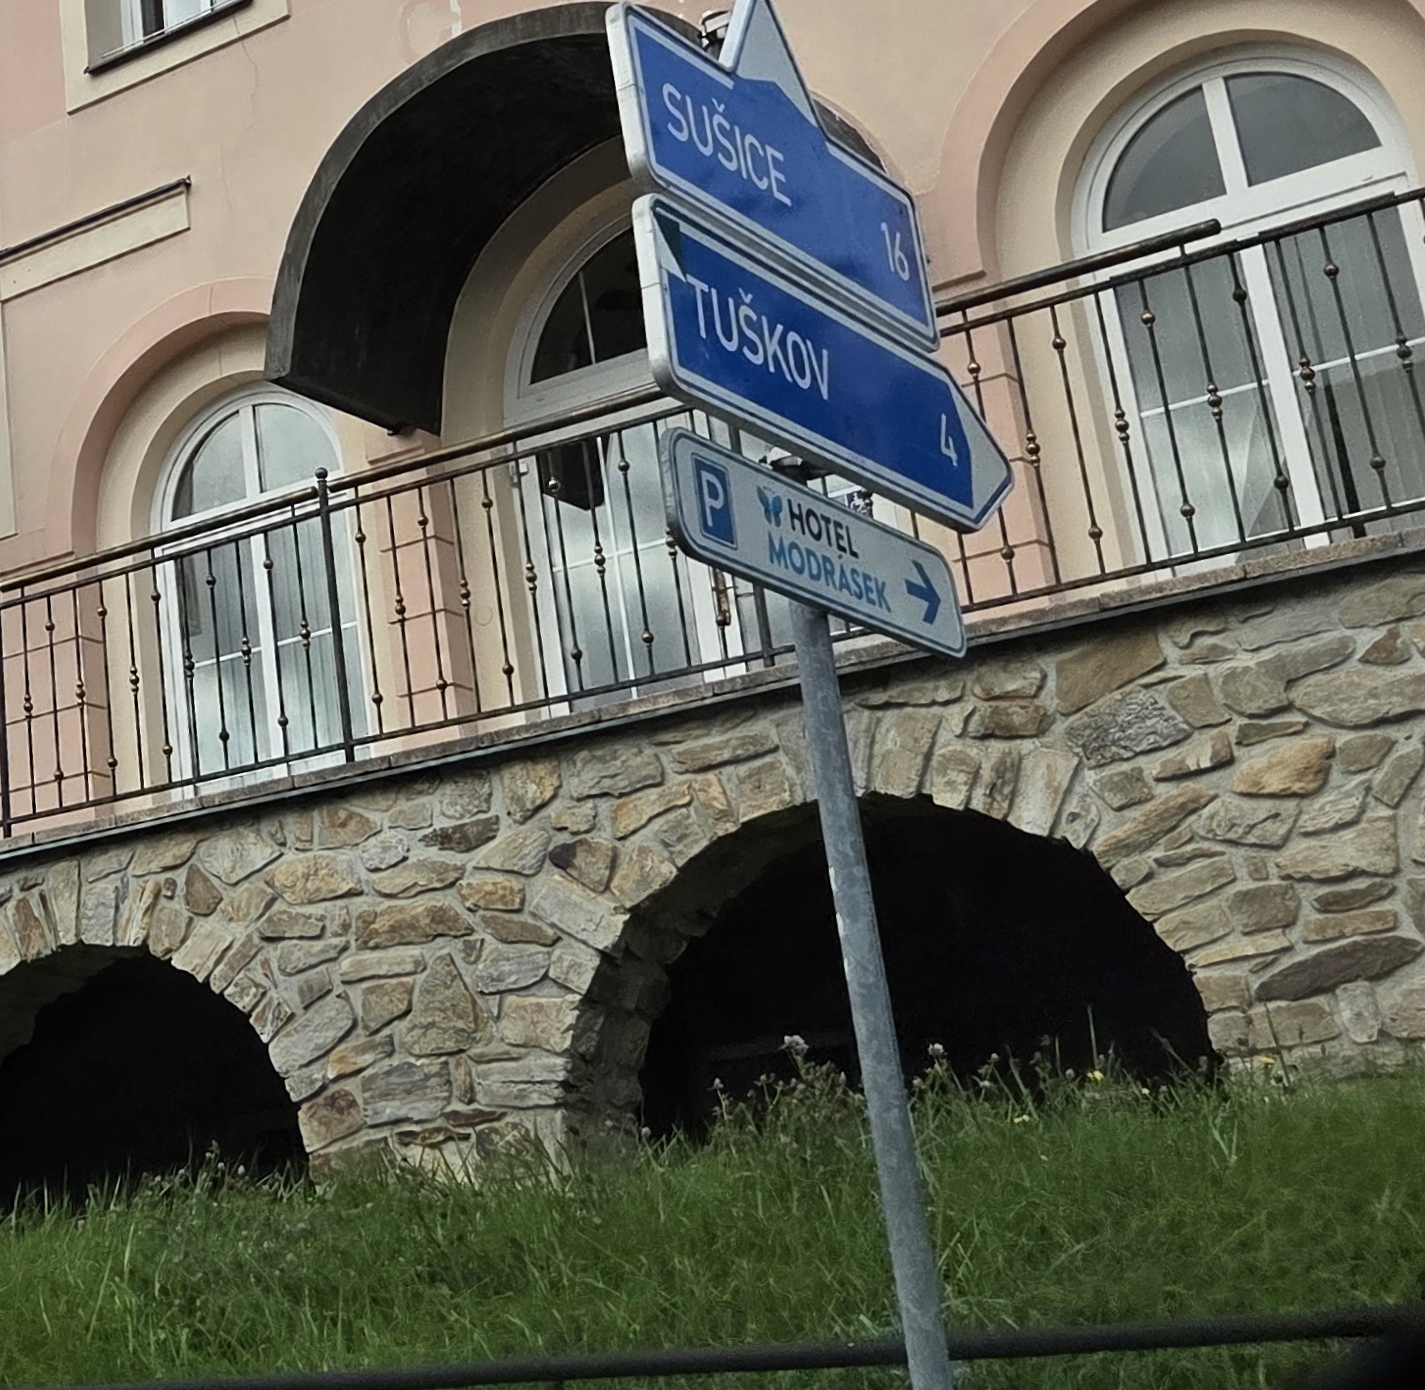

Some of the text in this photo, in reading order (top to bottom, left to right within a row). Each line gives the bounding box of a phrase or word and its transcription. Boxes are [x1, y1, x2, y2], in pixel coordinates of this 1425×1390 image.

[662, 83, 909, 281] SUŠICE 16
[686, 274, 958, 467] TUŠKOV 4
[701, 470, 724, 526] P
[787, 498, 859, 559] HOTEL
[768, 531, 892, 612] MODRÁSEK
